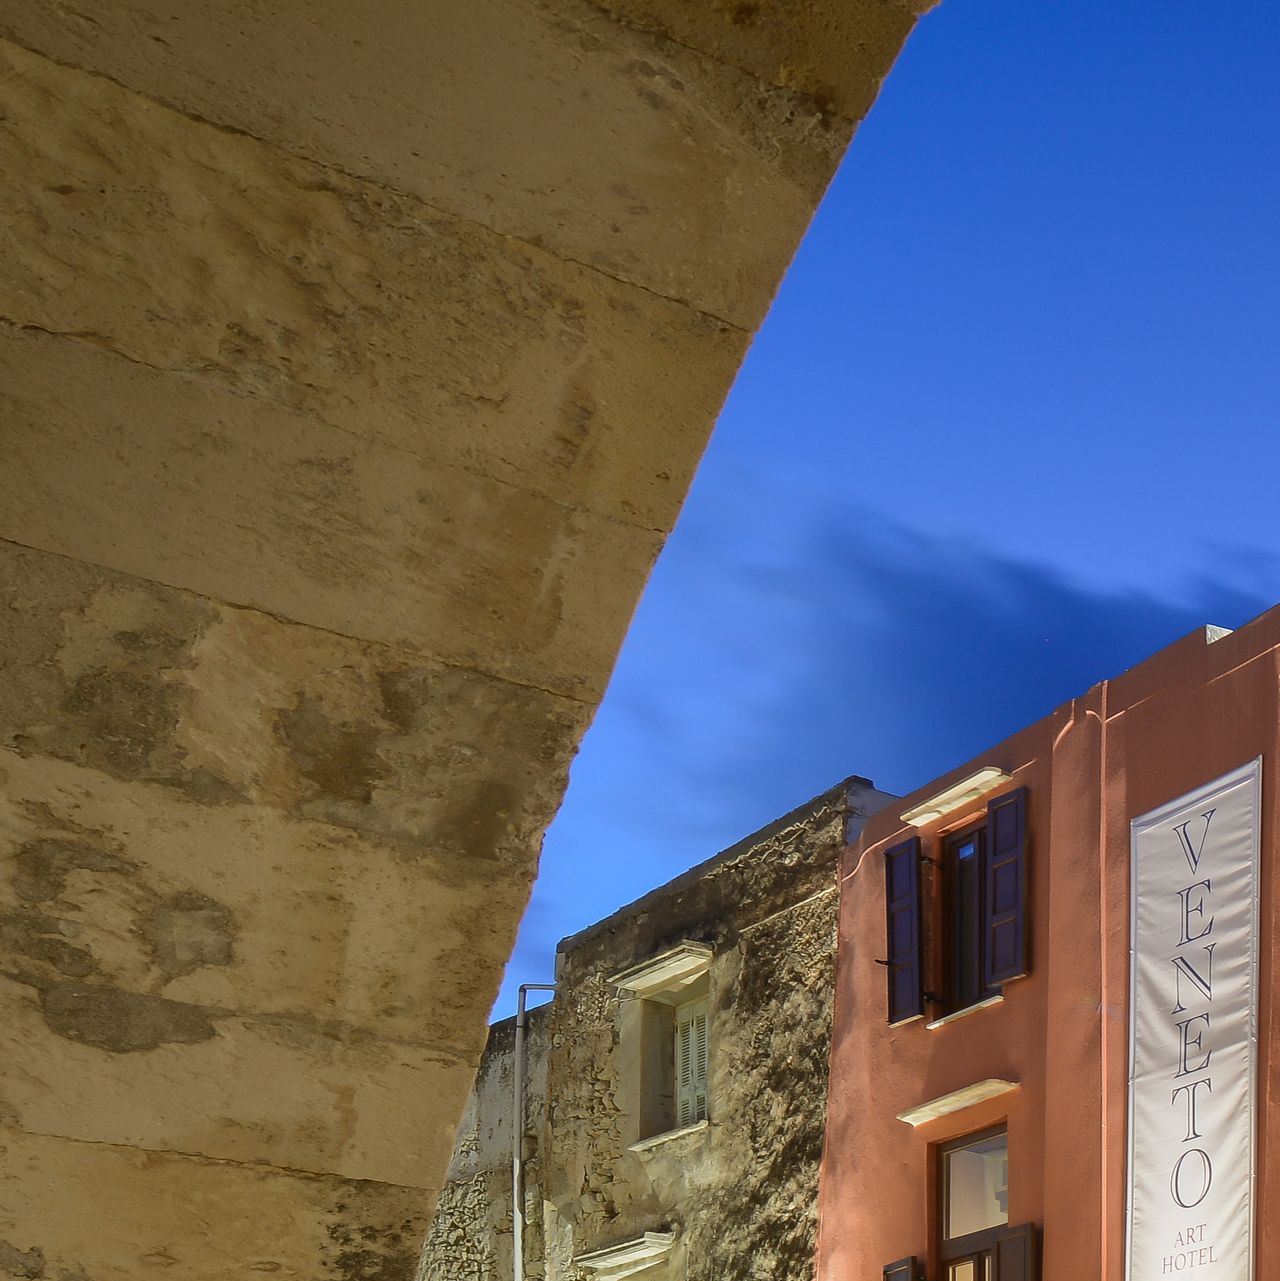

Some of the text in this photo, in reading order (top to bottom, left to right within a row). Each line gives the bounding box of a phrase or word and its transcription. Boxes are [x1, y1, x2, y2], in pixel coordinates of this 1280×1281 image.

[1171, 807, 1216, 1210] VENETO
[1174, 1224, 1207, 1248] ART
[1162, 1245, 1218, 1274] HOTEL
